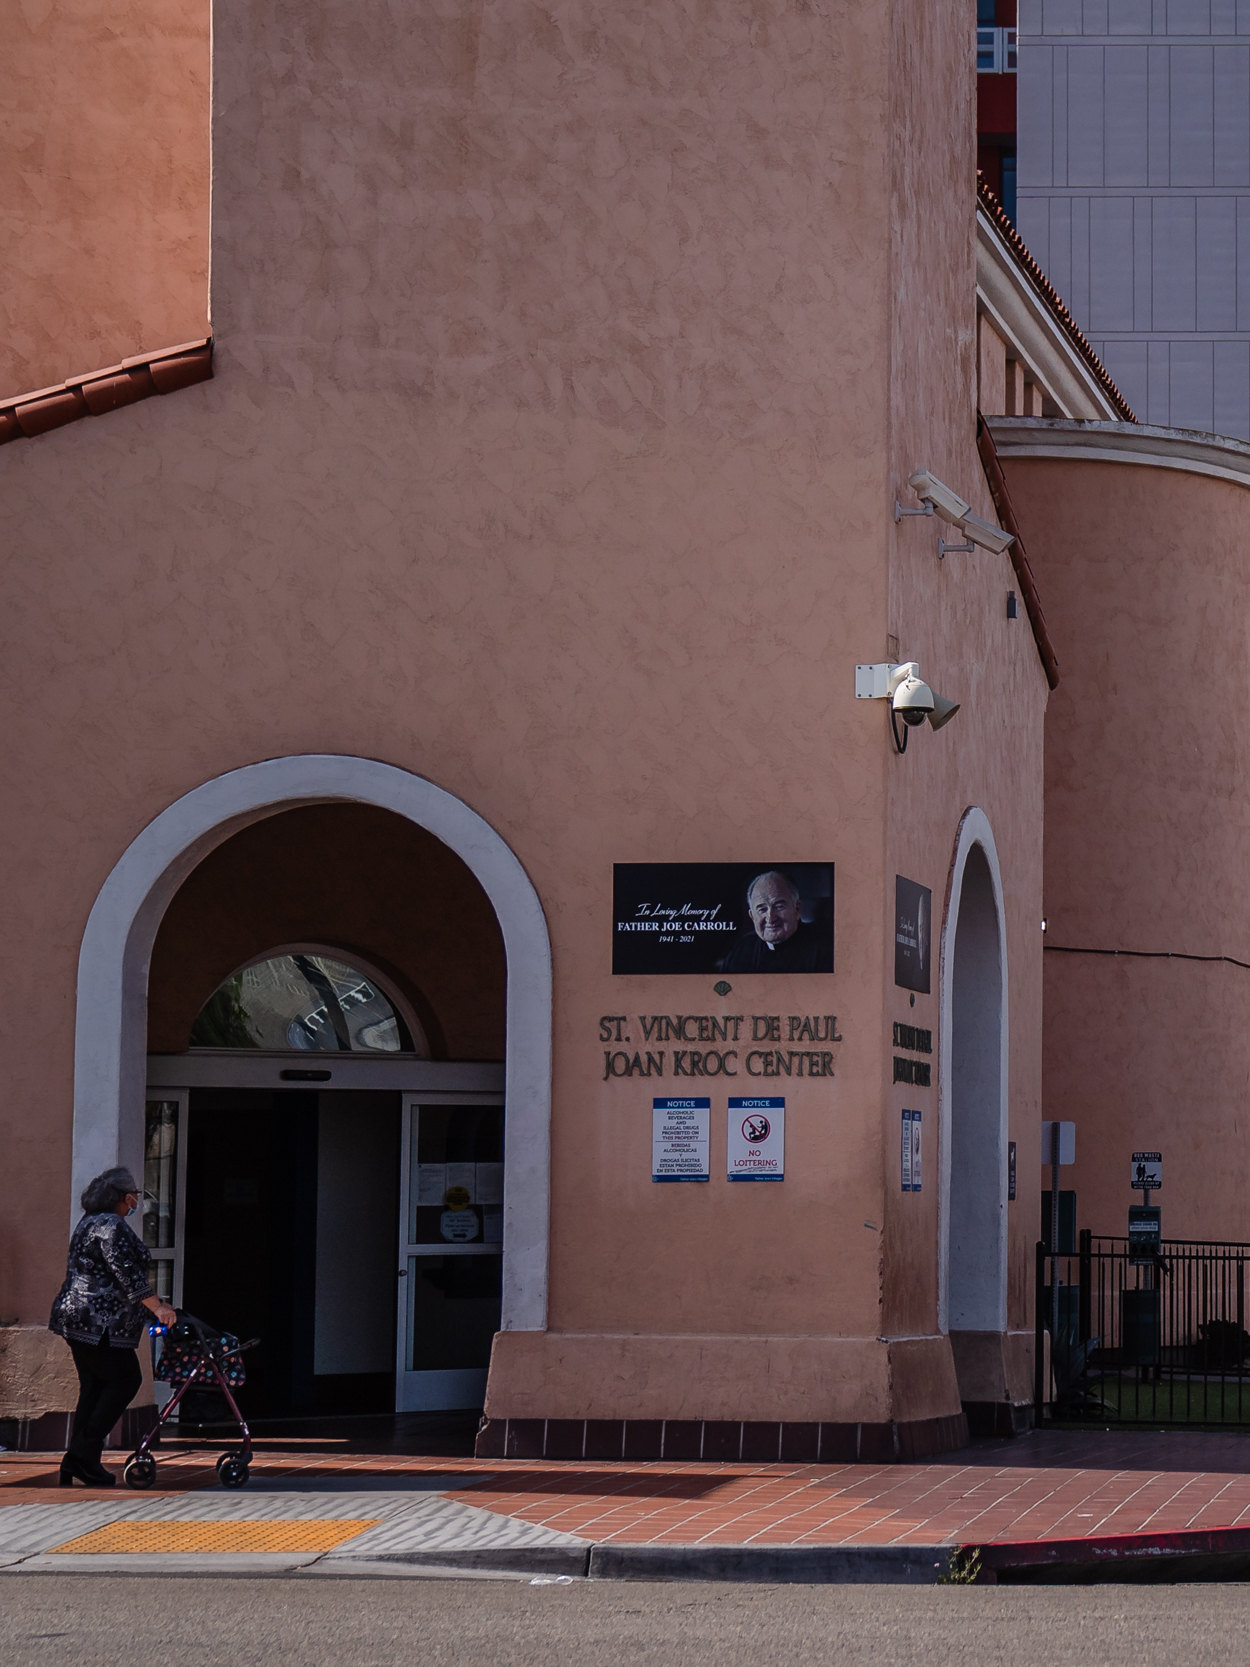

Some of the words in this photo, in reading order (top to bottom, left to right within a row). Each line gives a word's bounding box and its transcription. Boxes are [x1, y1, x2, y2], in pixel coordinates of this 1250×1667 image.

[635, 903, 651, 916] In
[651, 903, 677, 920] Loving
[675, 902, 710, 920] Memory
[710, 904, 722, 920] of
[618, 922, 660, 932] FATHER
[661, 922, 682, 932] JOE
[684, 922, 737, 931] CARROLL
[600, 1015, 630, 1042] ST.
[638, 1014, 744, 1042] VINCENT
[751, 1015, 781, 1042] DE
[788, 1015, 842, 1042] PAUL
[602, 1050, 664, 1081] JOAN
[673, 1050, 738, 1076] KROC
[746, 1050, 834, 1076] CENTER
